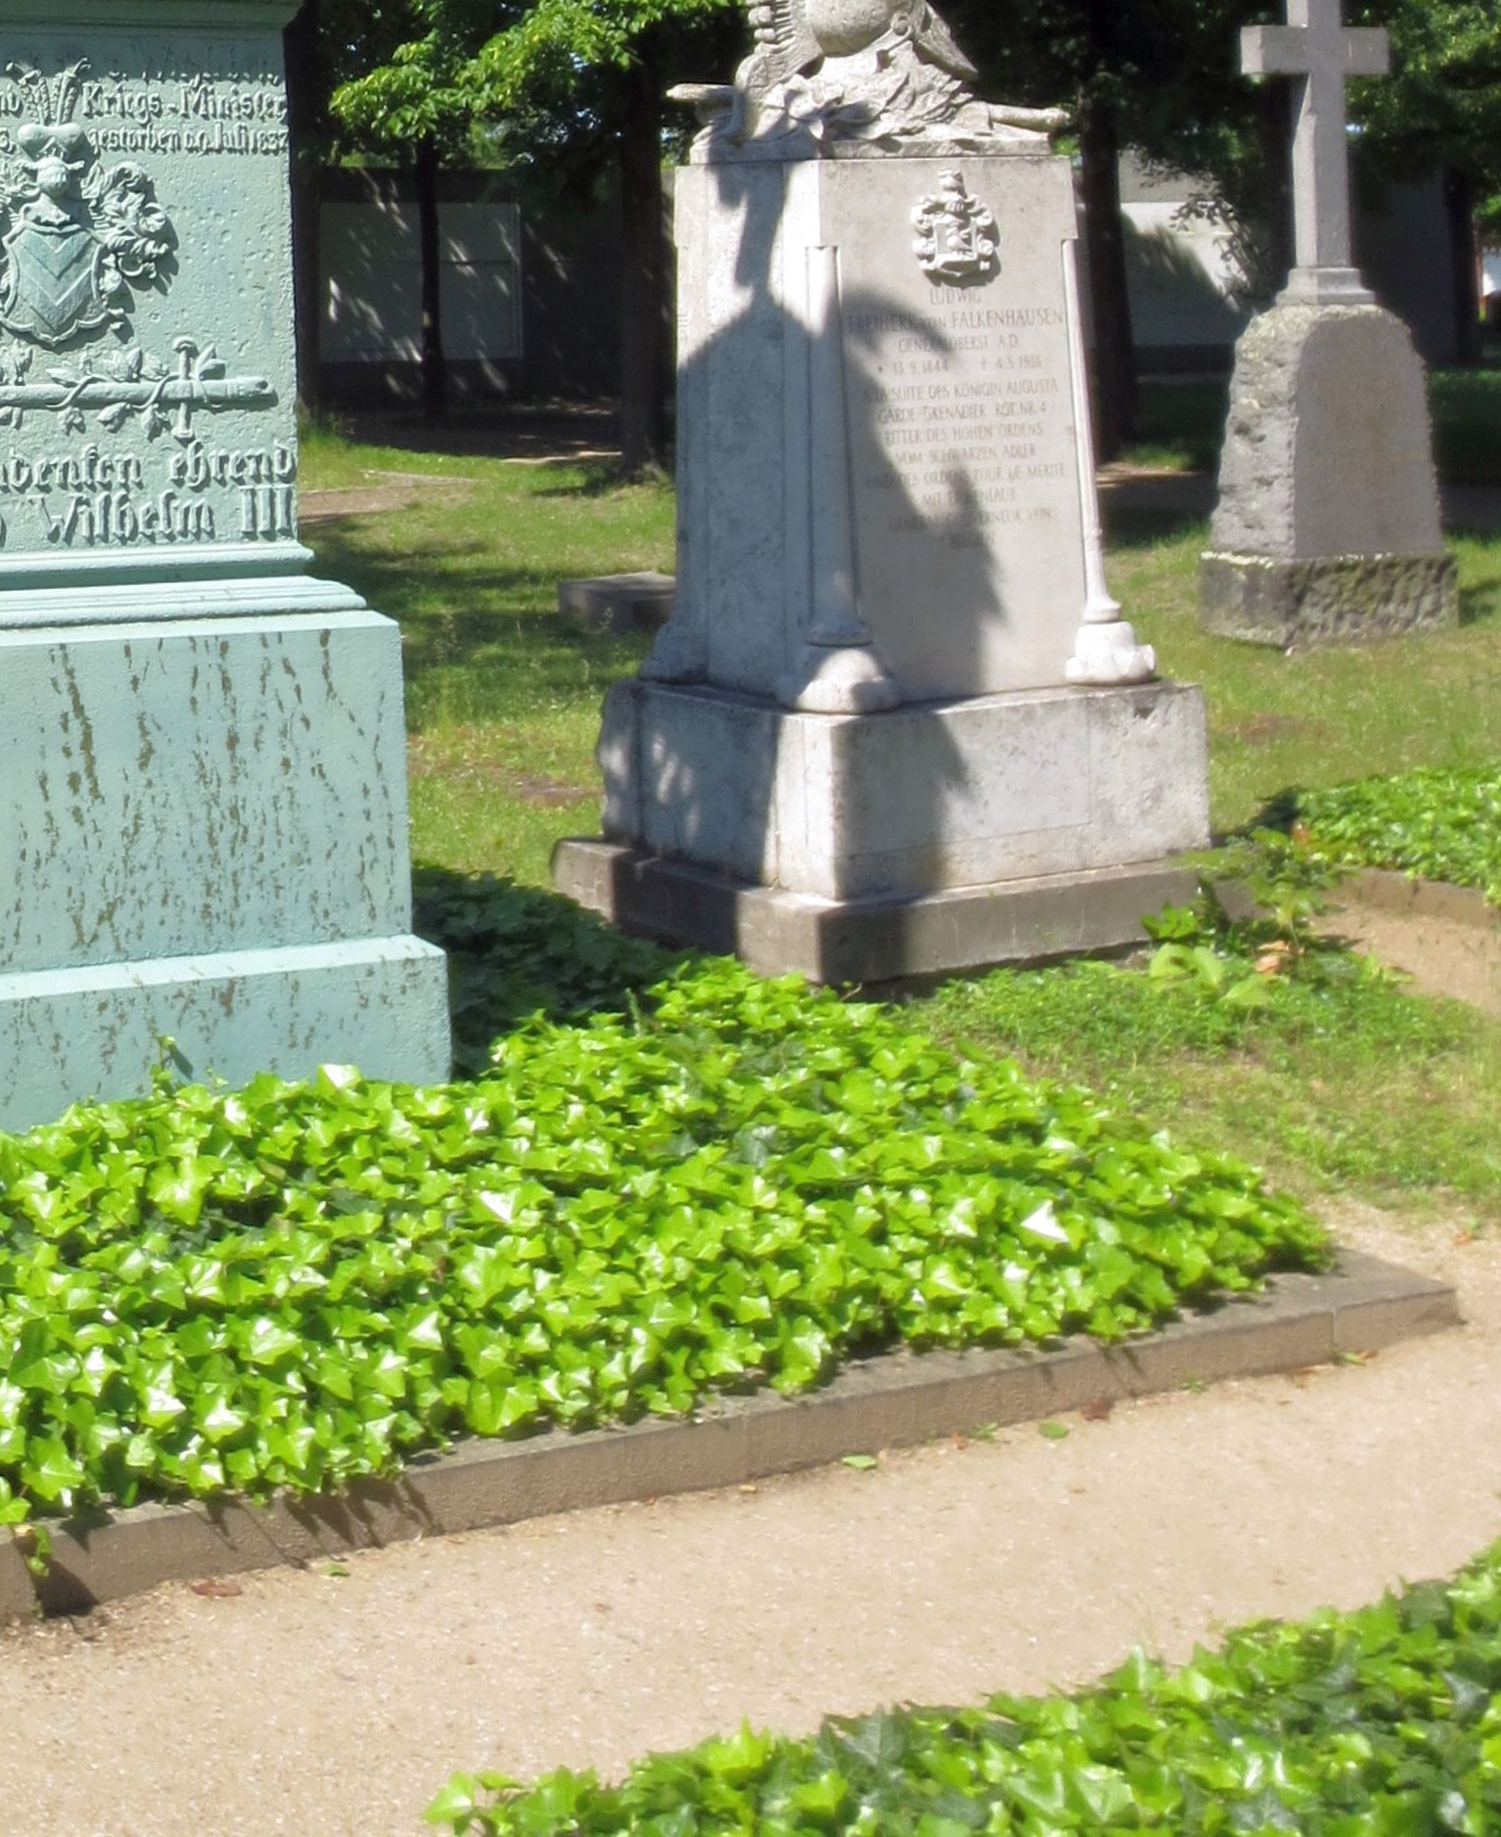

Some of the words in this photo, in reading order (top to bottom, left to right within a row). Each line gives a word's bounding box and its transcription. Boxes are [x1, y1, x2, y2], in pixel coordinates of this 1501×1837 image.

[88, 124, 181, 154] gestorben
[930, 288, 982, 305] LUDWIG
[951, 307, 1063, 329] FALKENHAUSEN
[893, 386, 924, 402] SUITE
[1006, 378, 1059, 394] AUGUSTA
[885, 428, 922, 444] RITTER
[926, 427, 948, 442] DES
[953, 425, 993, 441] HOHEN
[998, 422, 1044, 438] ORDENS
[167, 440, 298, 488] ehrend
[928, 446, 997, 463] SCHWARZEN
[1002, 444, 1036, 459] ADLER
[28, 488, 216, 546] Wilhelm
